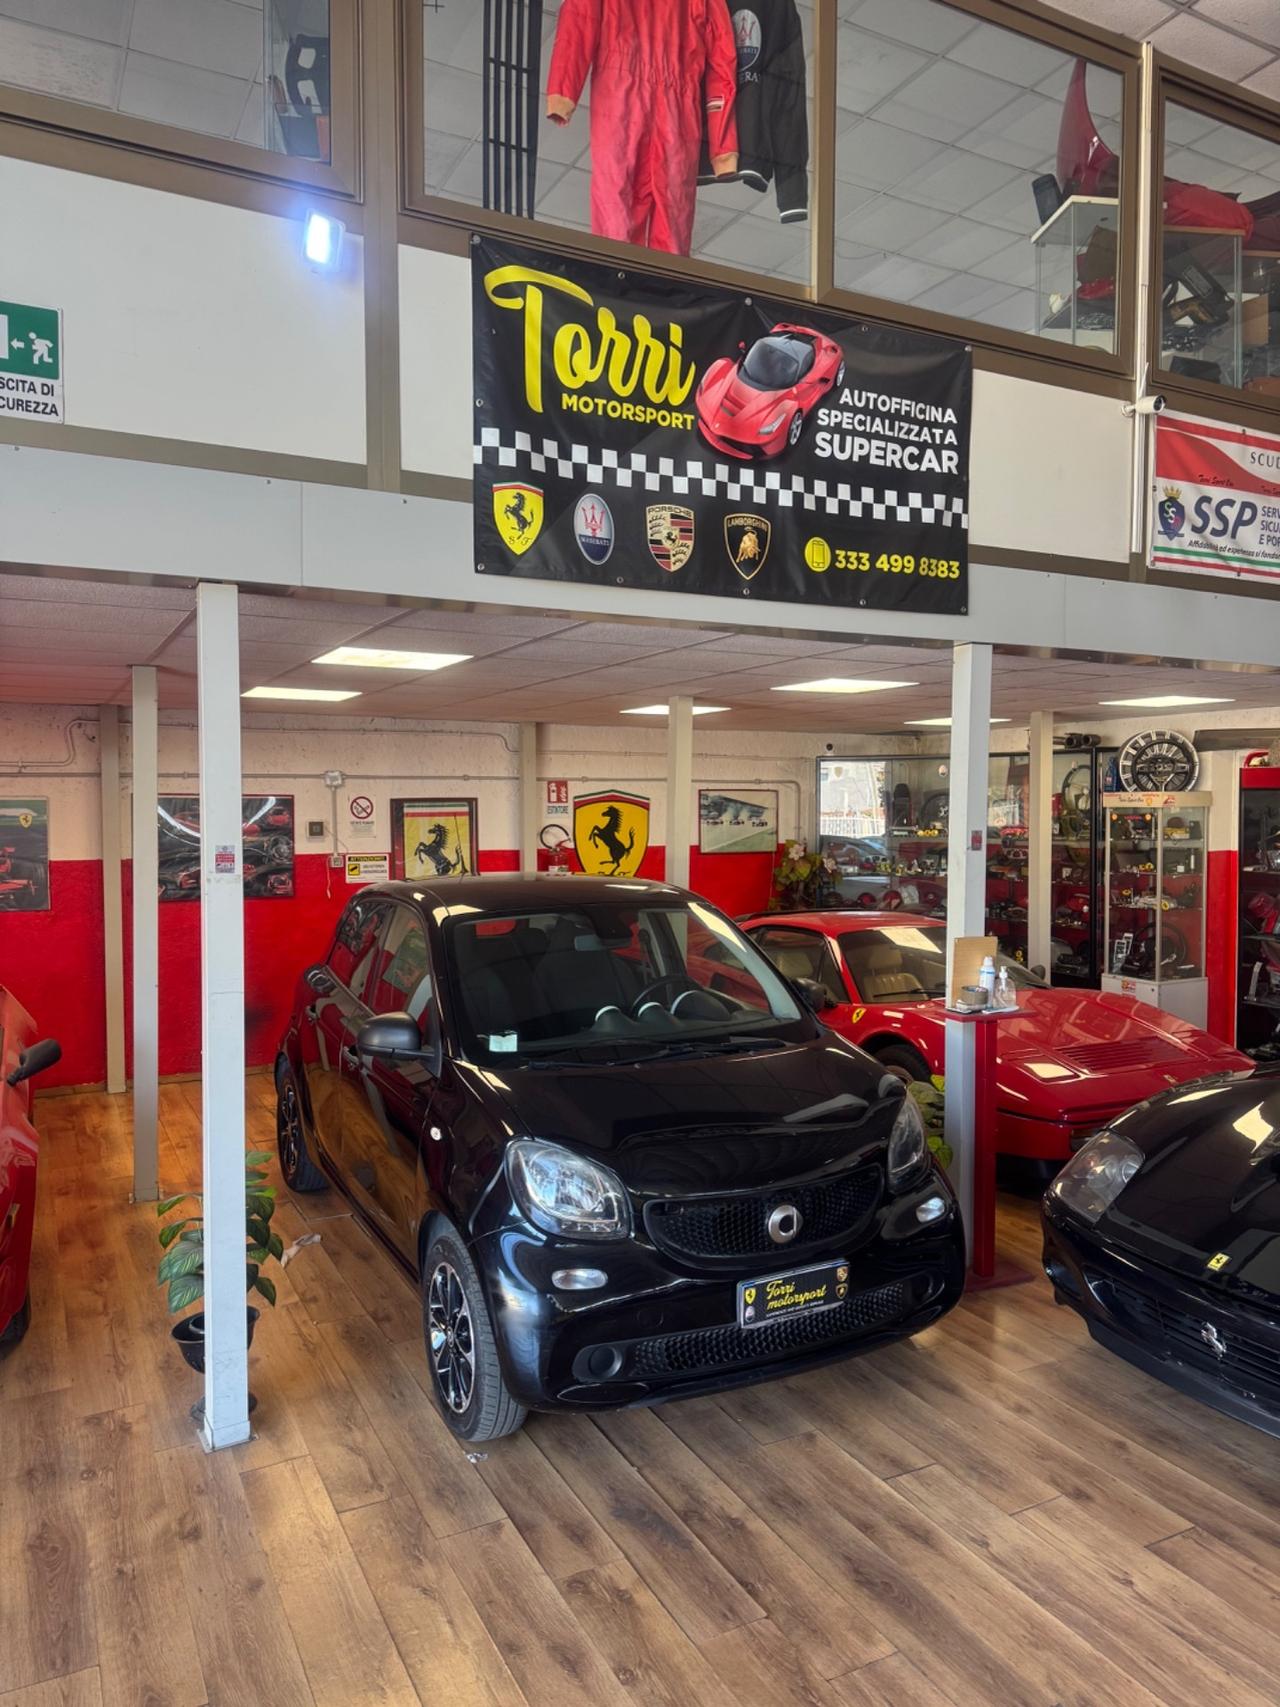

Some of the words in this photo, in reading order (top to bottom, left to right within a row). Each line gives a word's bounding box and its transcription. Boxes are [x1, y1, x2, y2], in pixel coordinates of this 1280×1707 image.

[484, 265, 696, 413] Torri
[0, 376, 37, 394] SCITA
[40, 382, 55, 397] DI
[0, 396, 59, 416] CUREZZA
[561, 393, 696, 430] MOTORSPORT
[839, 388, 958, 424] AUTOFFICINA
[816, 408, 958, 445] SPECIALIZZATA
[814, 431, 959, 475] SUPERCAR
[647, 505, 692, 517] PORSCHE
[1191, 495, 1258, 539] SSP
[1258, 534, 1265, 545] E
[835, 549, 870, 571] 333
[875, 554, 915, 574] 499
[918, 556, 960, 579] 8383
[766, 1280, 795, 1299] Torri
[766, 1284, 827, 1310] motorsport
